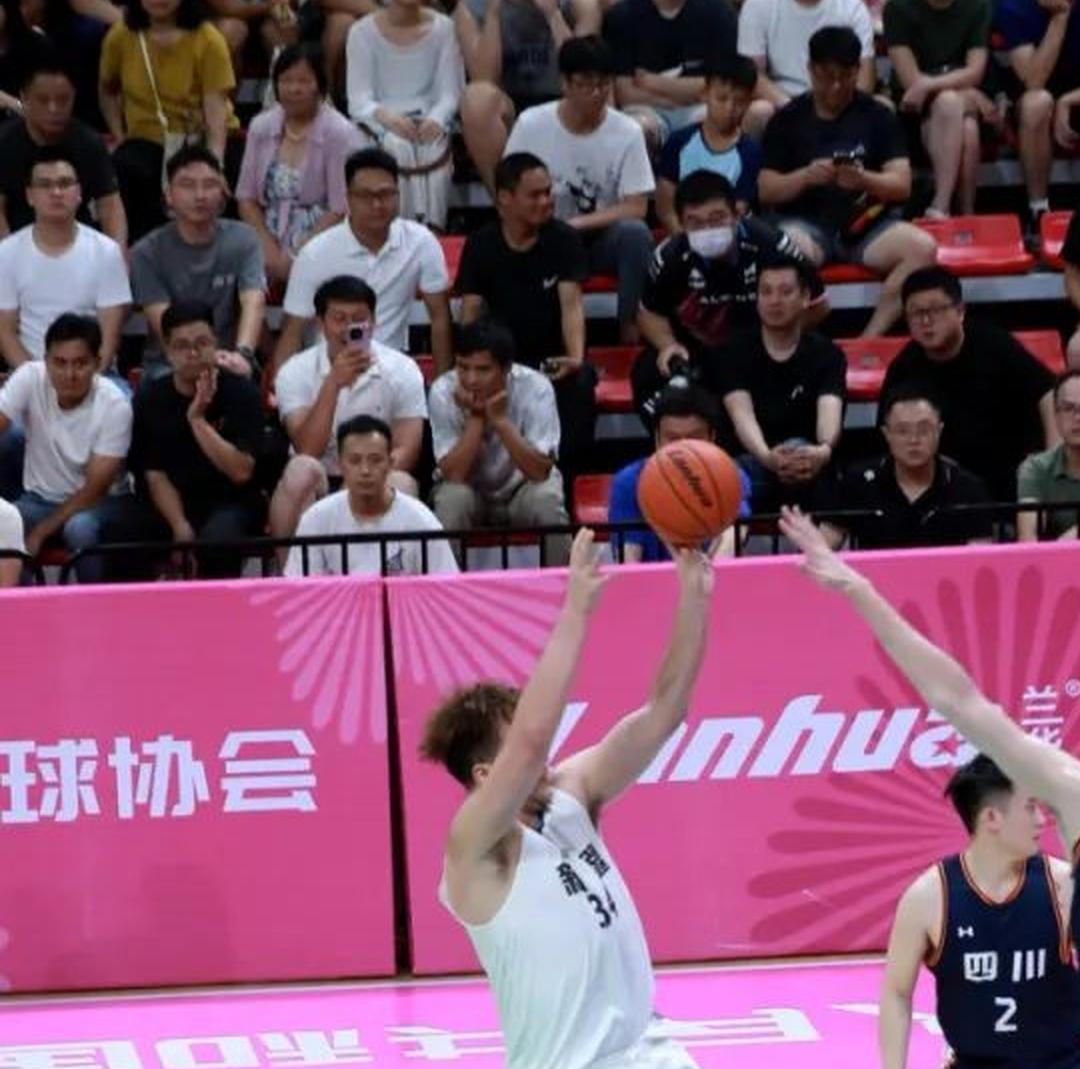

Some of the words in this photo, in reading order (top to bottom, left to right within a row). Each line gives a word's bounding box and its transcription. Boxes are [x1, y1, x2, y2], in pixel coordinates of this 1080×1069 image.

[547, 694, 979, 785] nhua
[0, 728, 319, 824] 球协会
[962, 947, 1047, 983] 四川
[993, 995, 1018, 1032] 2
